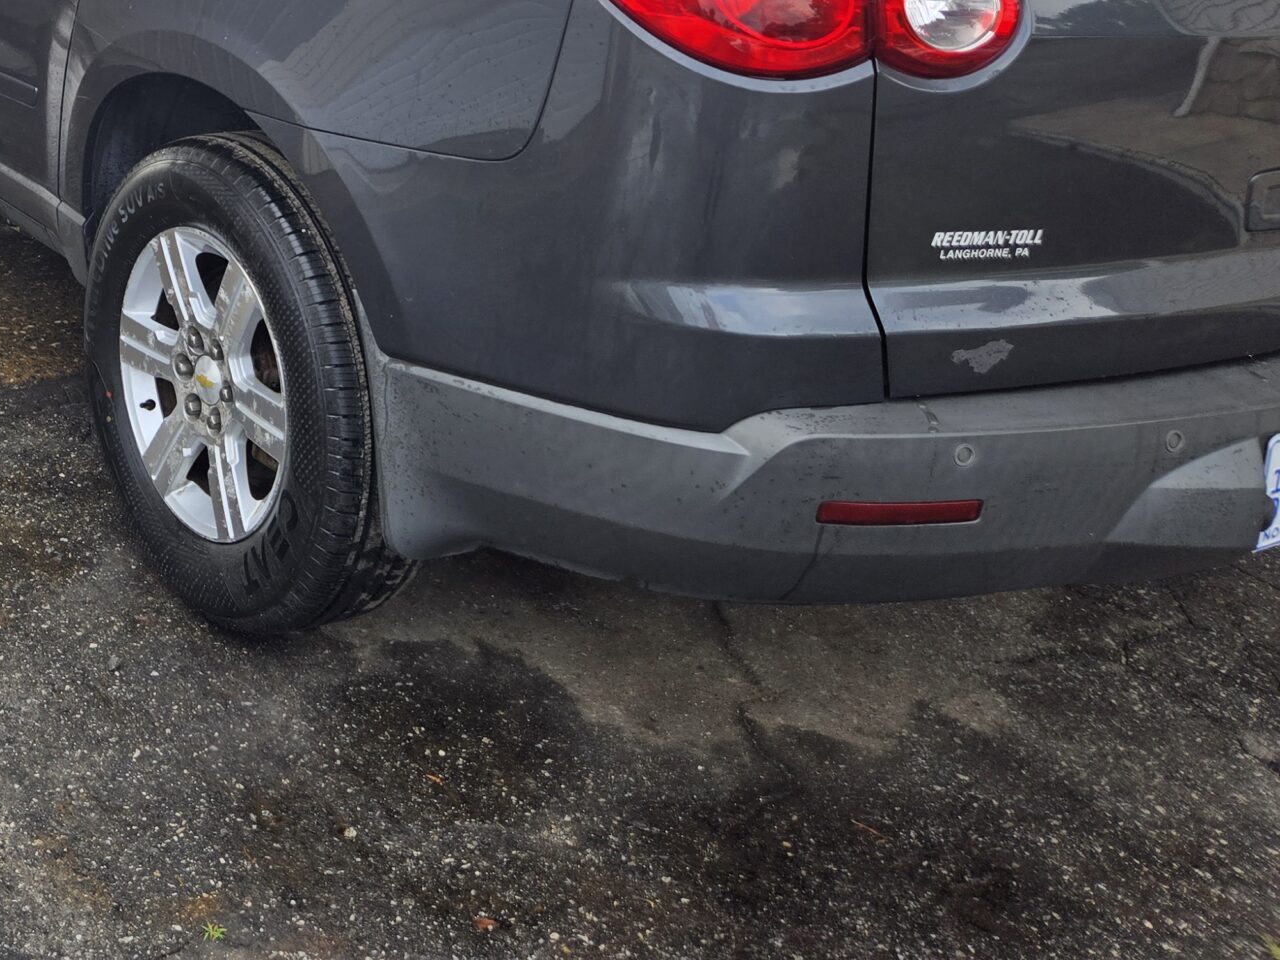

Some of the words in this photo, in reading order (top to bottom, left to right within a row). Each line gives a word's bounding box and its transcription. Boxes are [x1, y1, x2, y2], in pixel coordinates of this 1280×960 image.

[118, 184, 144, 223] SUV
[931, 229, 1043, 247] REEDMAN-TOLL
[1015, 247, 1030, 257] PA
[242, 489, 298, 589] CEAT
